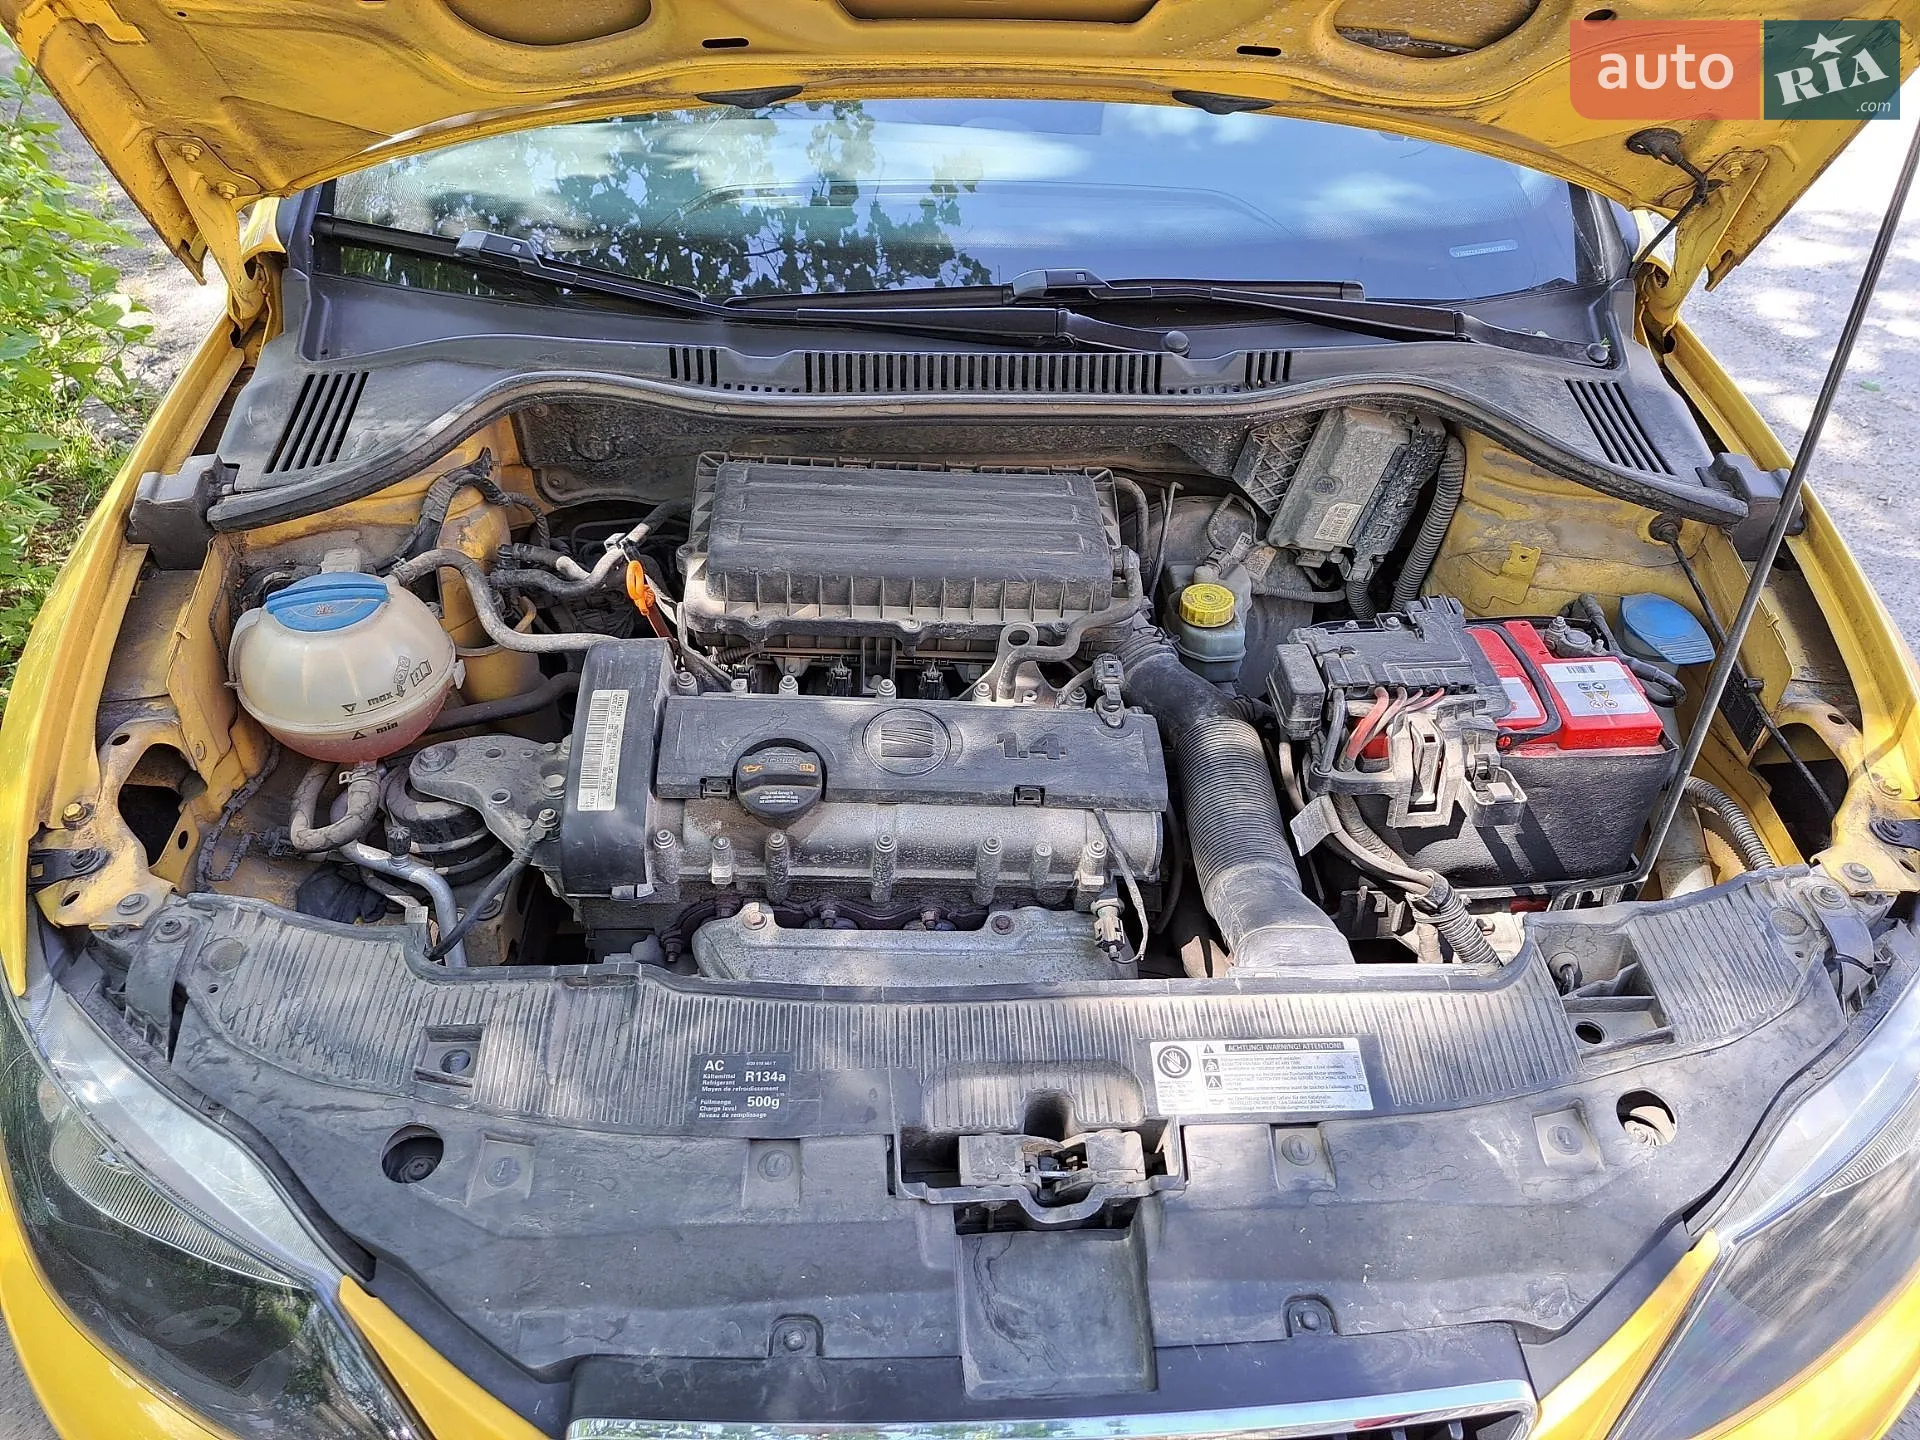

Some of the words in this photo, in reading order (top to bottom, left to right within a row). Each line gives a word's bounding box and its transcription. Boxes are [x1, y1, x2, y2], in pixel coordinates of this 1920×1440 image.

[367, 692, 394, 706] max
[376, 721, 399, 734] min
[996, 732, 1067, 760] 1.4
[704, 1060, 725, 1071] AC
[744, 1071, 786, 1082] R134a
[747, 1096, 780, 1110] 500g
